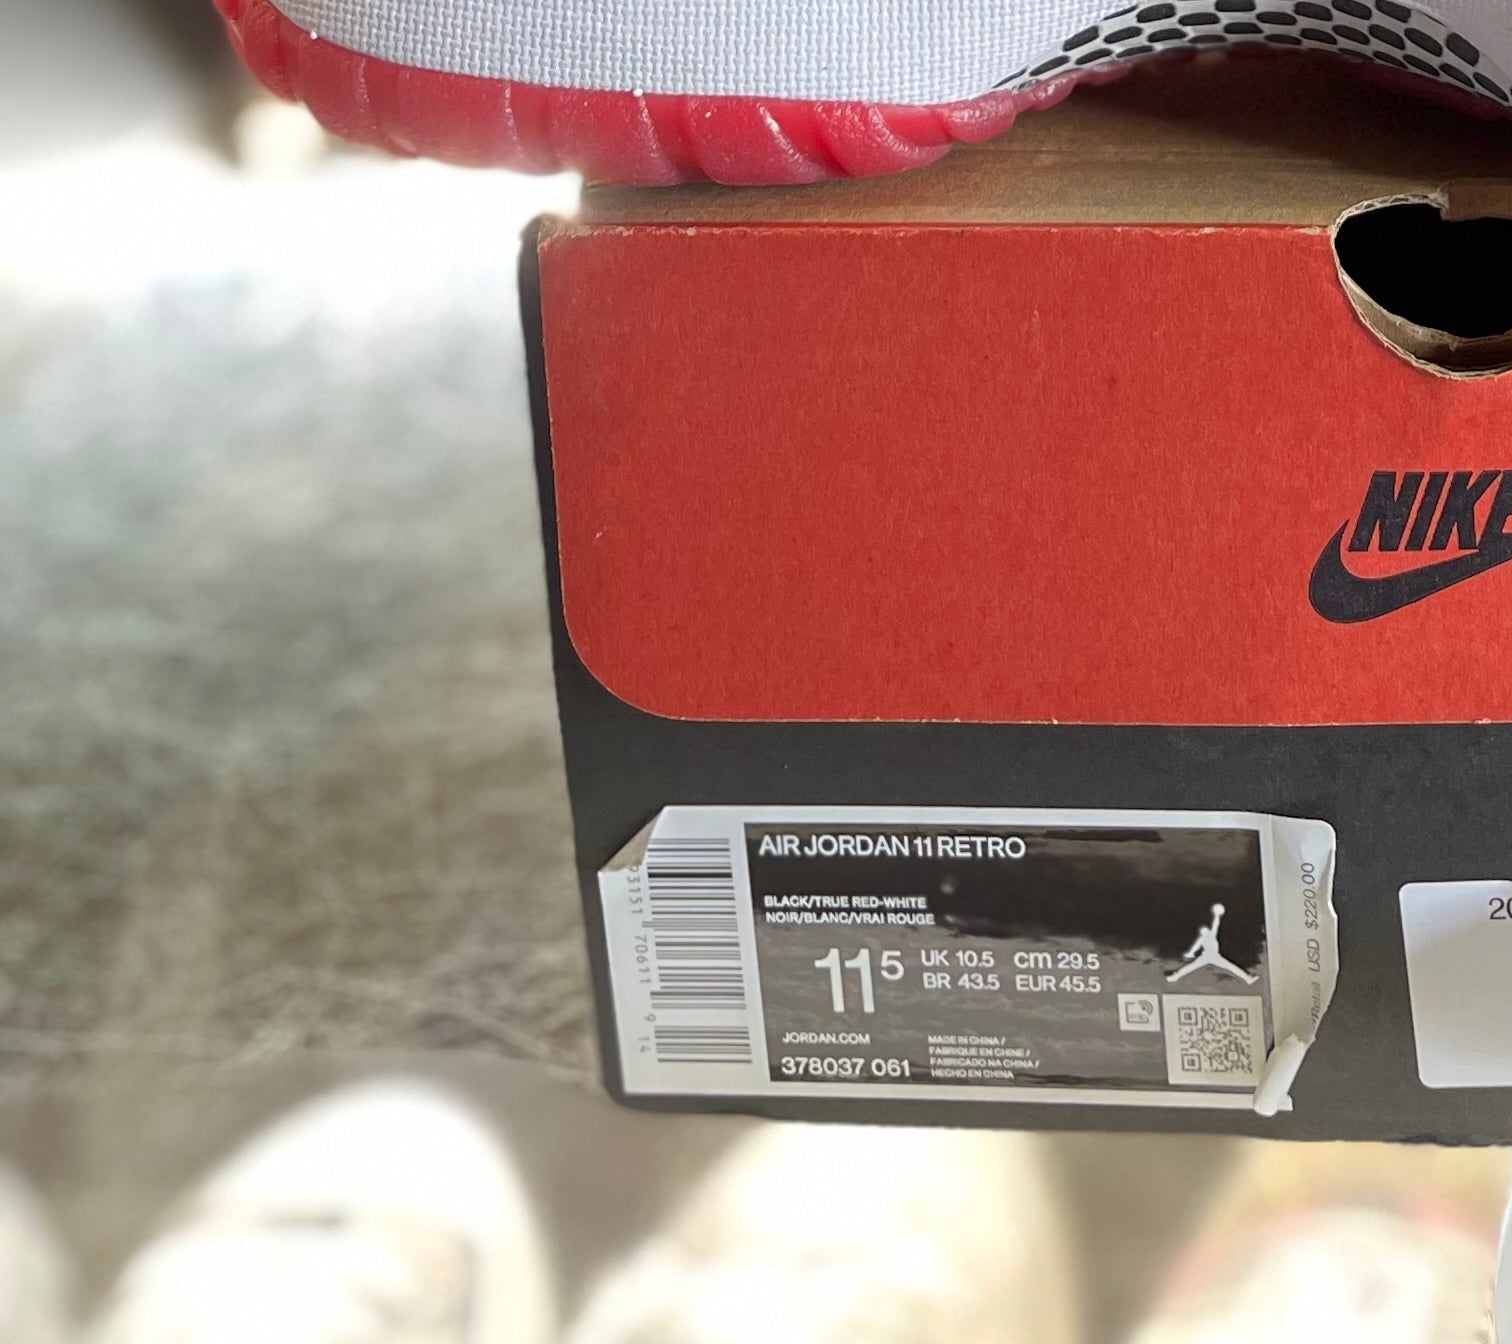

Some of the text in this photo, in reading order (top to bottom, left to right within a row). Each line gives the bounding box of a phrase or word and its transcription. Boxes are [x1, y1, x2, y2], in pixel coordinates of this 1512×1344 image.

[758, 834, 1027, 859] AIR JORDAN 11 RETRO
[763, 895, 928, 910] BLACK/TRUE RED-WHITE
[1300, 862, 1319, 931] $220.00
[765, 912, 936, 926] NOIR/BLANC/VRAI ROUGE
[920, 949, 950, 967] UK
[955, 950, 995, 968] 10.5
[1056, 952, 1101, 971] 29.5
[1306, 938, 1321, 972] USD
[923, 972, 1102, 994] BR 43.5 EUR 45.5
[782, 1031, 871, 1045] JORDAN.COM
[927, 1034, 957, 1045] MADE
[957, 1035, 968, 1045] IN
[968, 1035, 1000, 1046] CHINA
[780, 1056, 911, 1078] 378037 061
[930, 1068, 1014, 1079] HECHO EN CHINA
